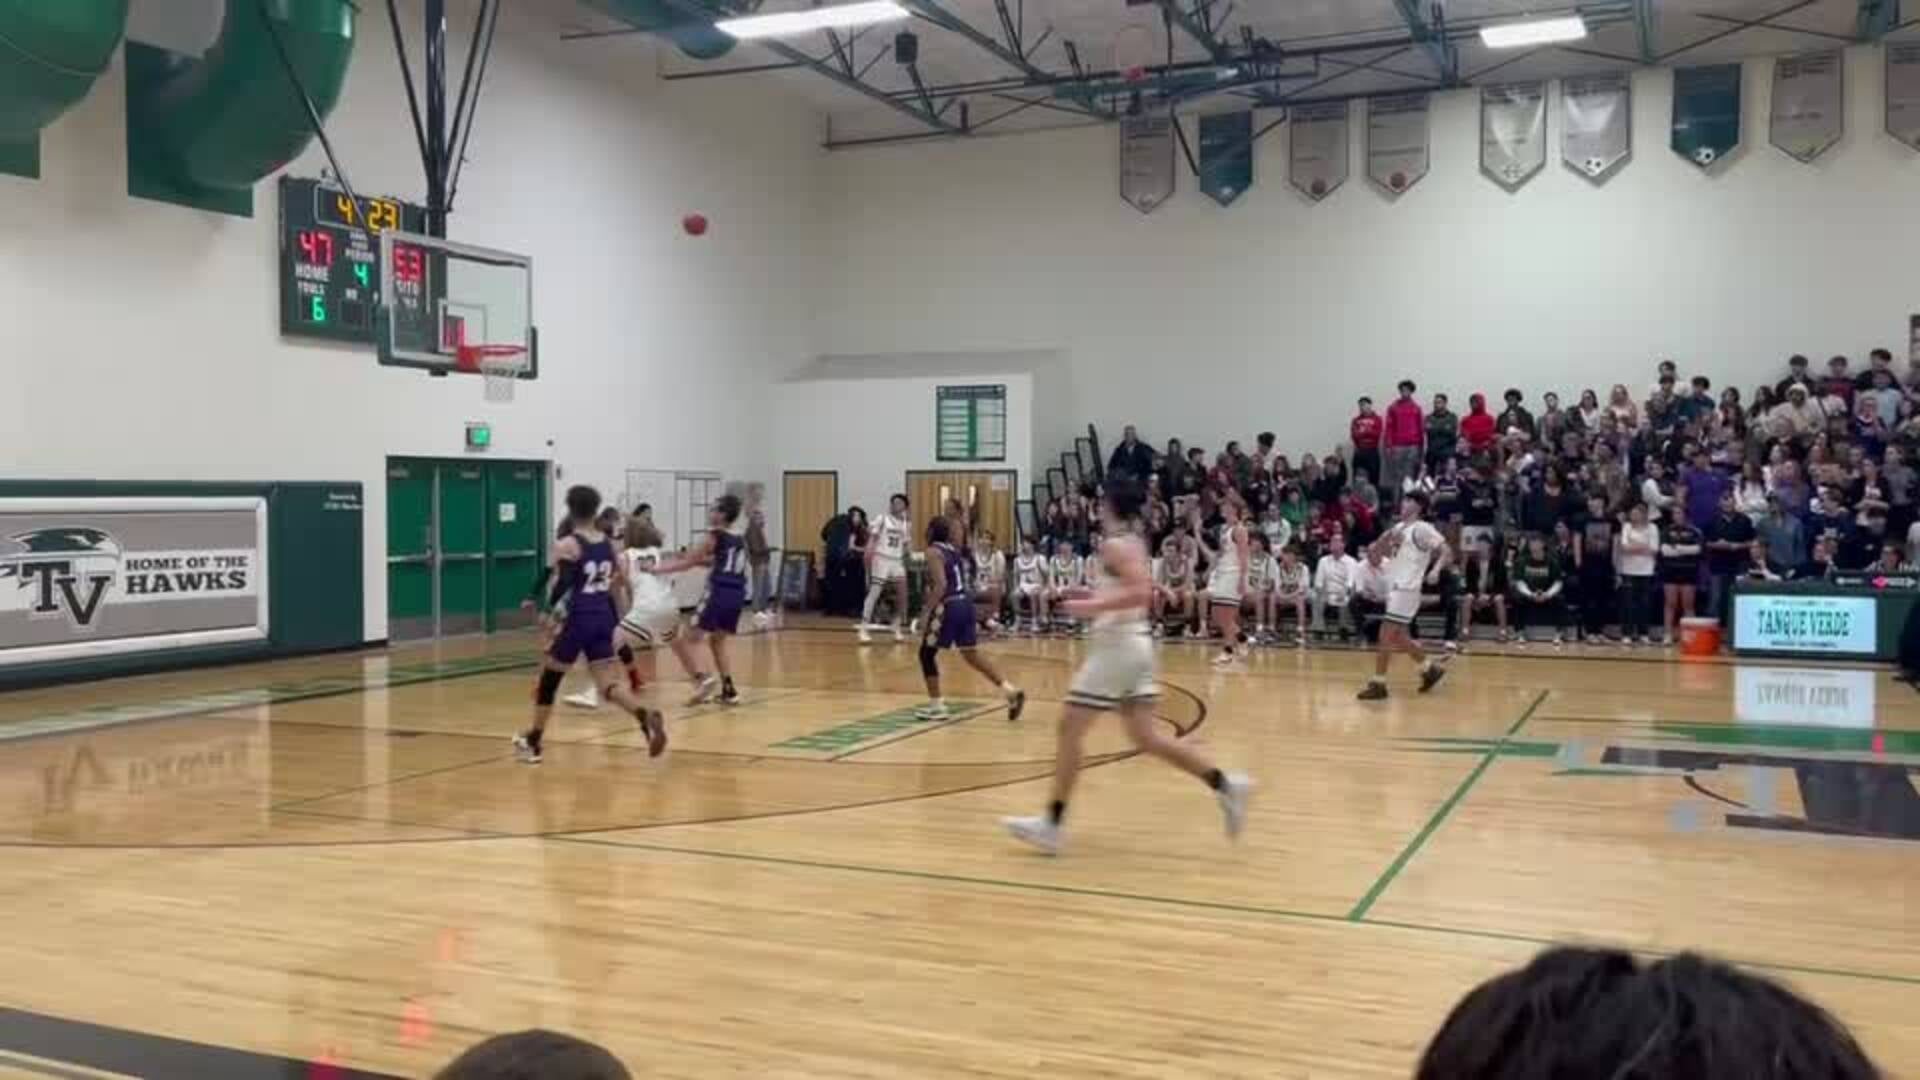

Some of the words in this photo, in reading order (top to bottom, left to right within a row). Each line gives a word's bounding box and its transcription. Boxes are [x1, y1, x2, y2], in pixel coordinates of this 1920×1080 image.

[368, 201, 398, 234] 23
[300, 230, 333, 265] 47
[295, 263, 328, 282] HOME
[354, 263, 368, 287] 4
[395, 246, 421, 279] 53
[312, 296, 326, 322] 6
[126, 558, 183, 571] HOME
[187, 557, 210, 569] OF
[214, 556, 248, 568] THE
[582, 560, 613, 593] 23
[22, 561, 111, 625] TV
[126, 571, 247, 594] HAWKS
[1758, 610, 1807, 638] TANQUE
[1809, 611, 1850, 636] VERDE
